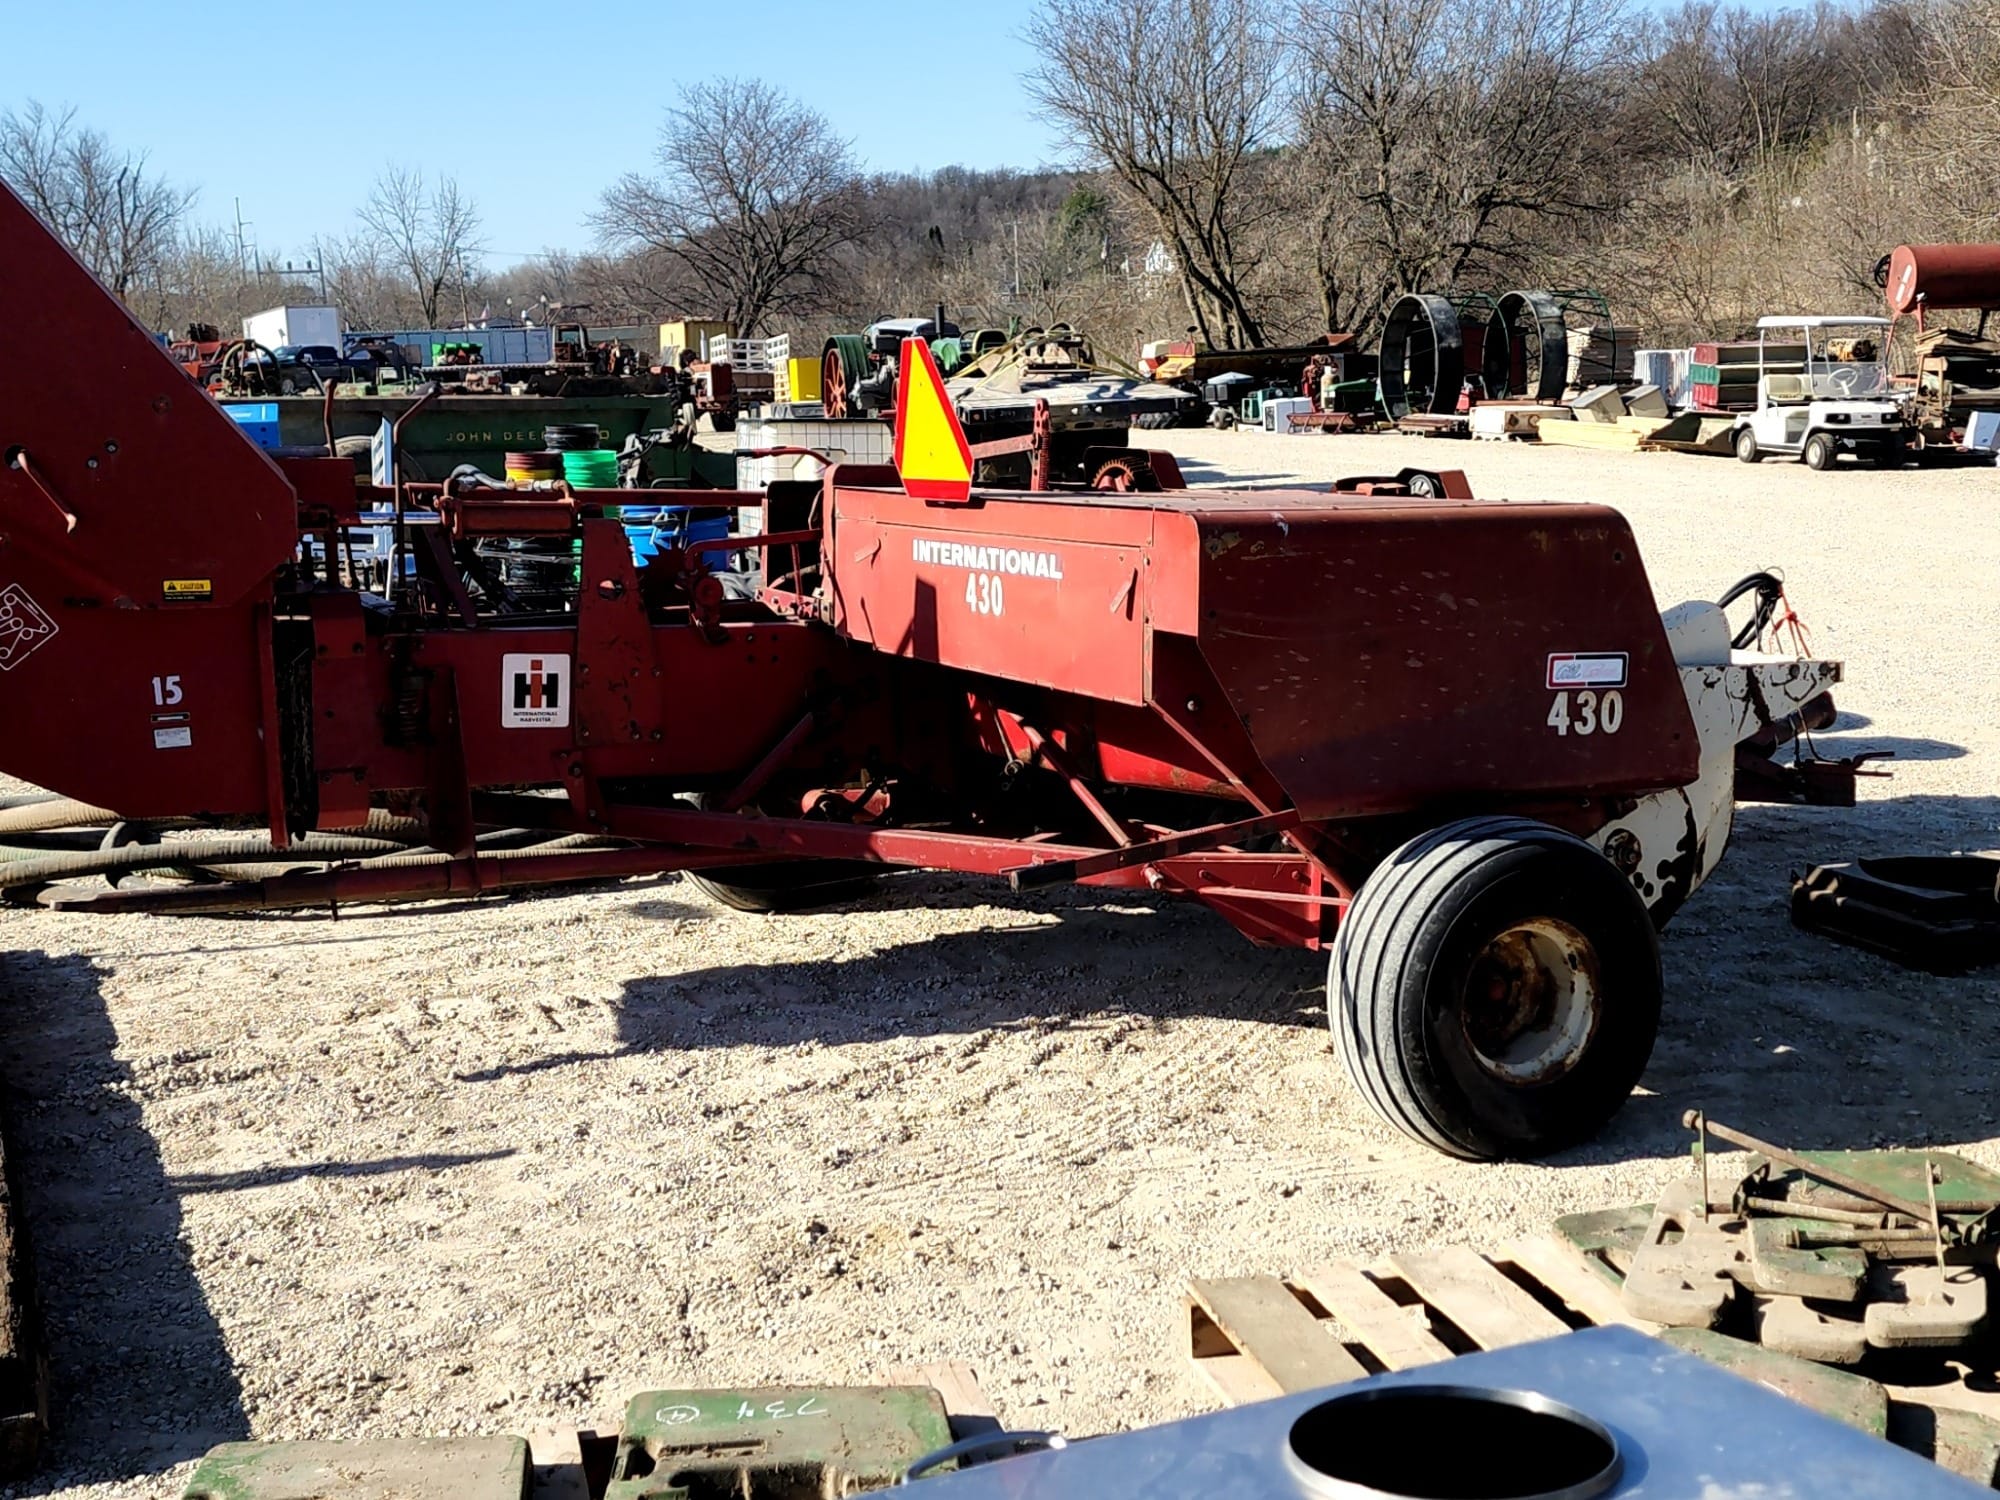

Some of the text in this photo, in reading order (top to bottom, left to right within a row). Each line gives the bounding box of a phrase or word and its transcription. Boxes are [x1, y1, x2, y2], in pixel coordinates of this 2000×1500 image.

[446, 432, 492, 442] JOHN
[912, 538, 1064, 580] INTERNATIONAL
[965, 572, 1004, 617] 430
[151, 675, 183, 706] 15
[1547, 690, 1623, 736] 430
